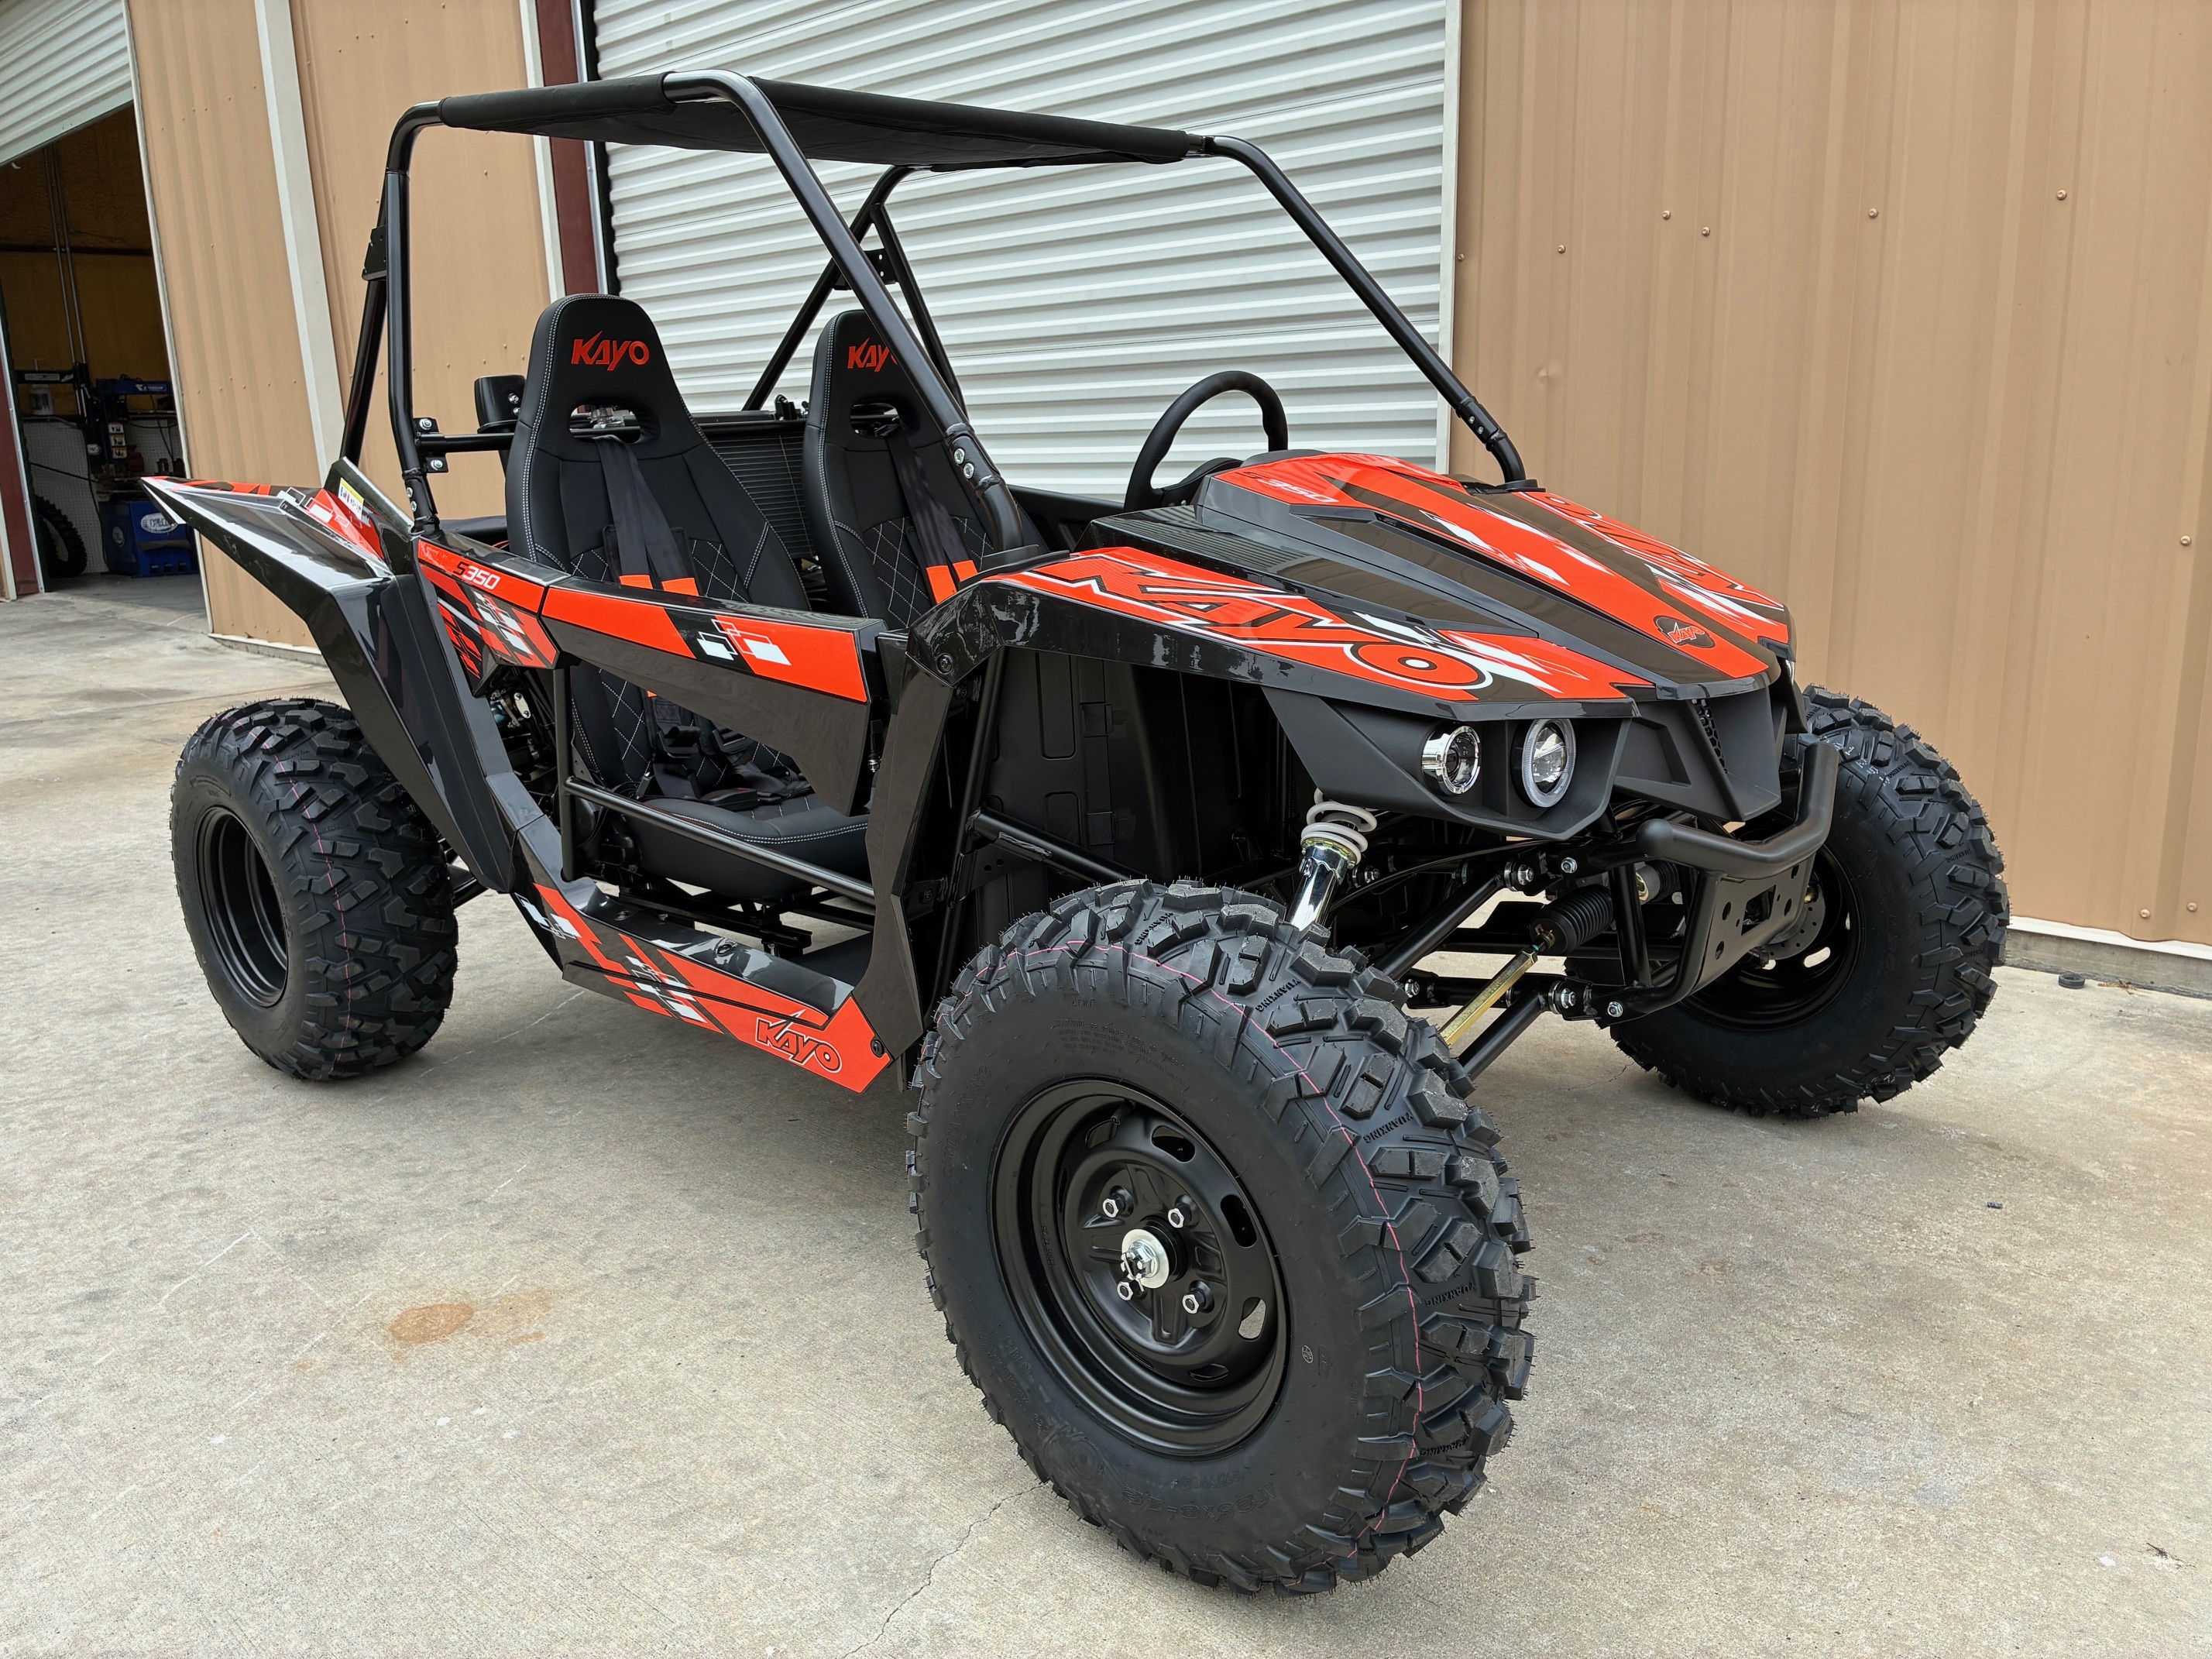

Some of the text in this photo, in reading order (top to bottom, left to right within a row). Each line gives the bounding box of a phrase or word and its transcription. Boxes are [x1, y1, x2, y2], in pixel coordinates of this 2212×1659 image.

[571, 330, 650, 371] KAYO
[847, 337, 898, 372] KAY
[452, 561, 501, 590] S350
[1024, 553, 1493, 689] KAYO
[756, 1008, 843, 1073] KAYO
[1362, 1111, 1414, 1144] YUANXING
[1424, 1282, 1478, 1307] YUANXING
